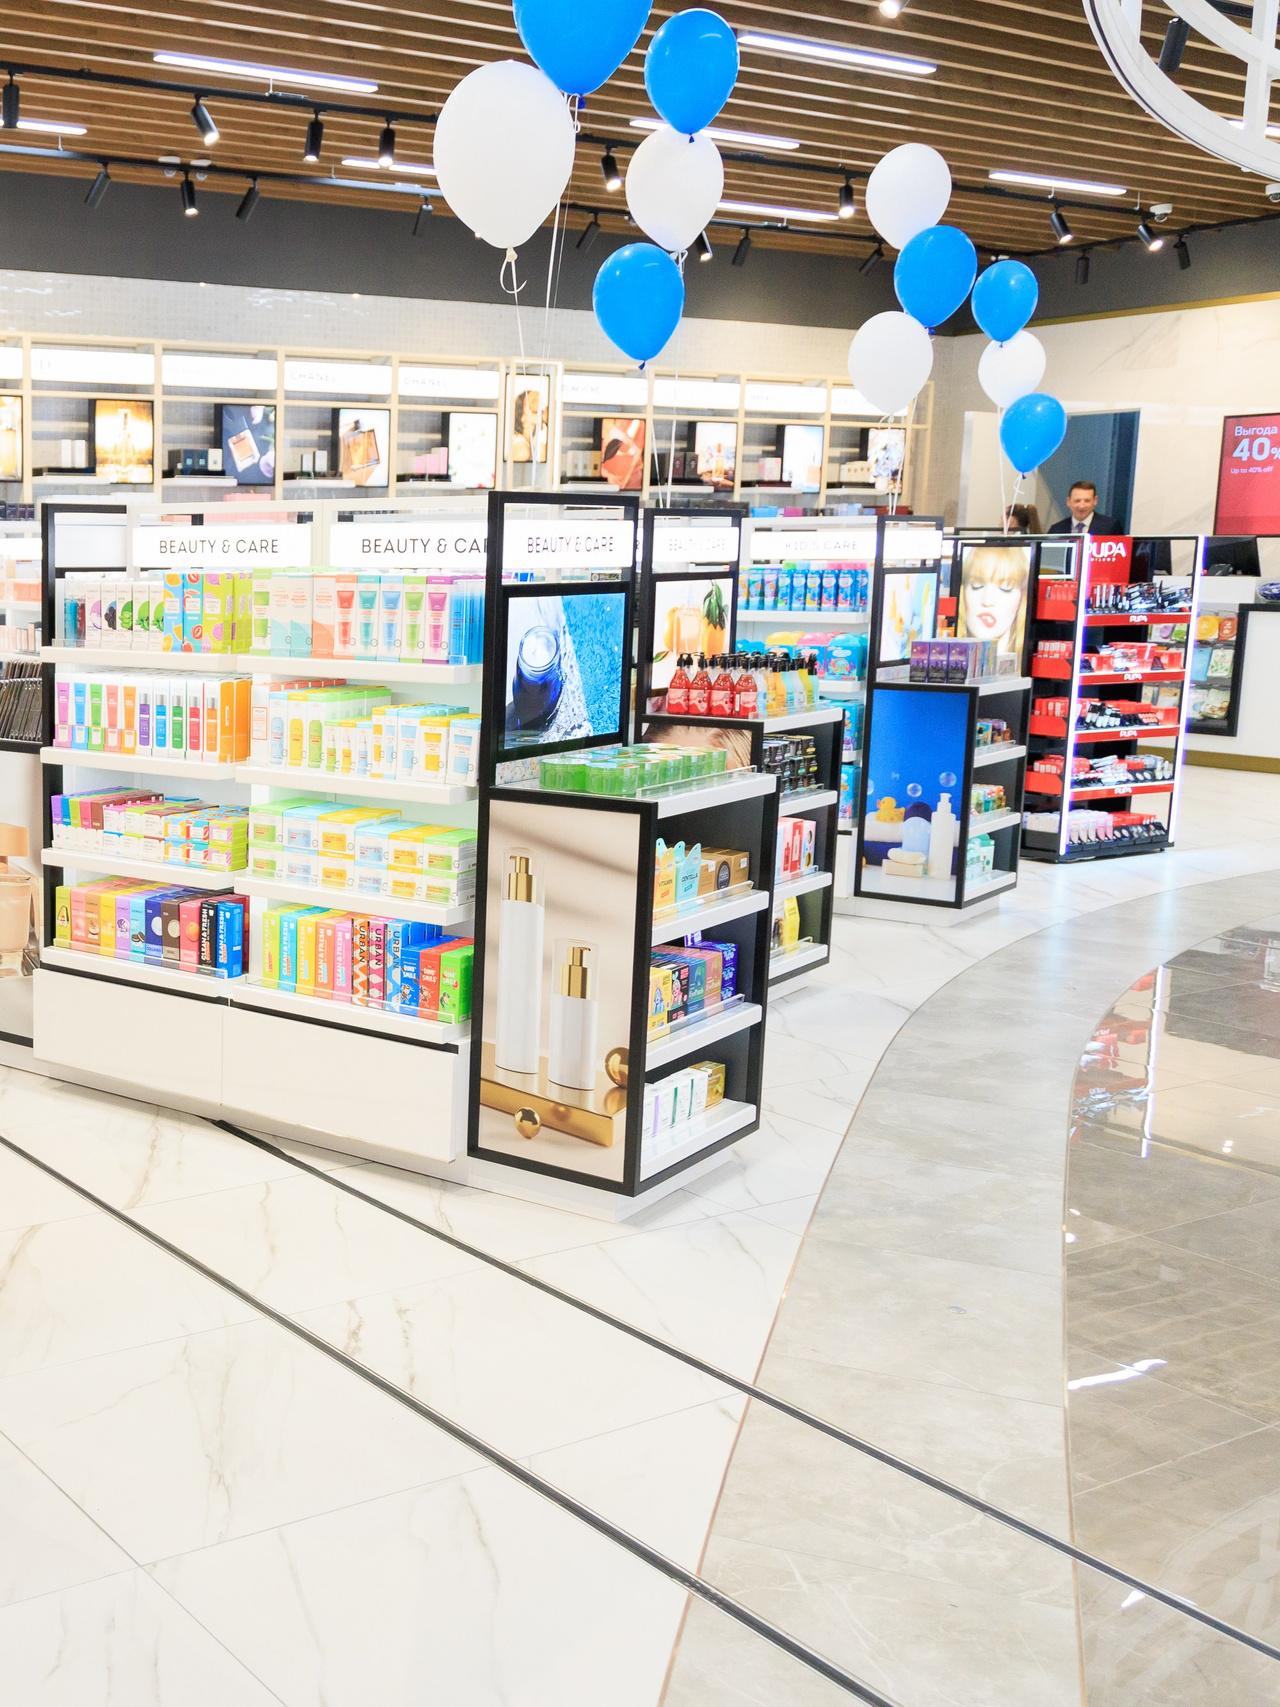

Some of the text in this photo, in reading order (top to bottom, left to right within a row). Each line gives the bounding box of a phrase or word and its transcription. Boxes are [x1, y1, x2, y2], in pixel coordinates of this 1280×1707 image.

[289, 371, 338, 384] CHANEL
[402, 376, 448, 388] CHANEL
[1234, 425, 1278, 437] Выгода
[1230, 467, 1240, 475] Up
[159, 538, 279, 554] BEAUTY & CARE
[361, 538, 431, 554] BEAUTY
[437, 538, 448, 554] &
[527, 536, 614, 554] BEAUTY & CARE
[823, 540, 859, 552] CARE
[1129, 615, 1148, 623] PUPA
[1123, 673, 1142, 681] PUPA
[1119, 730, 1138, 738] PUPA
[1114, 787, 1132, 795] PUPA
[681, 872, 698, 883] CENTELLA
[392, 930, 400, 969] URBAN
